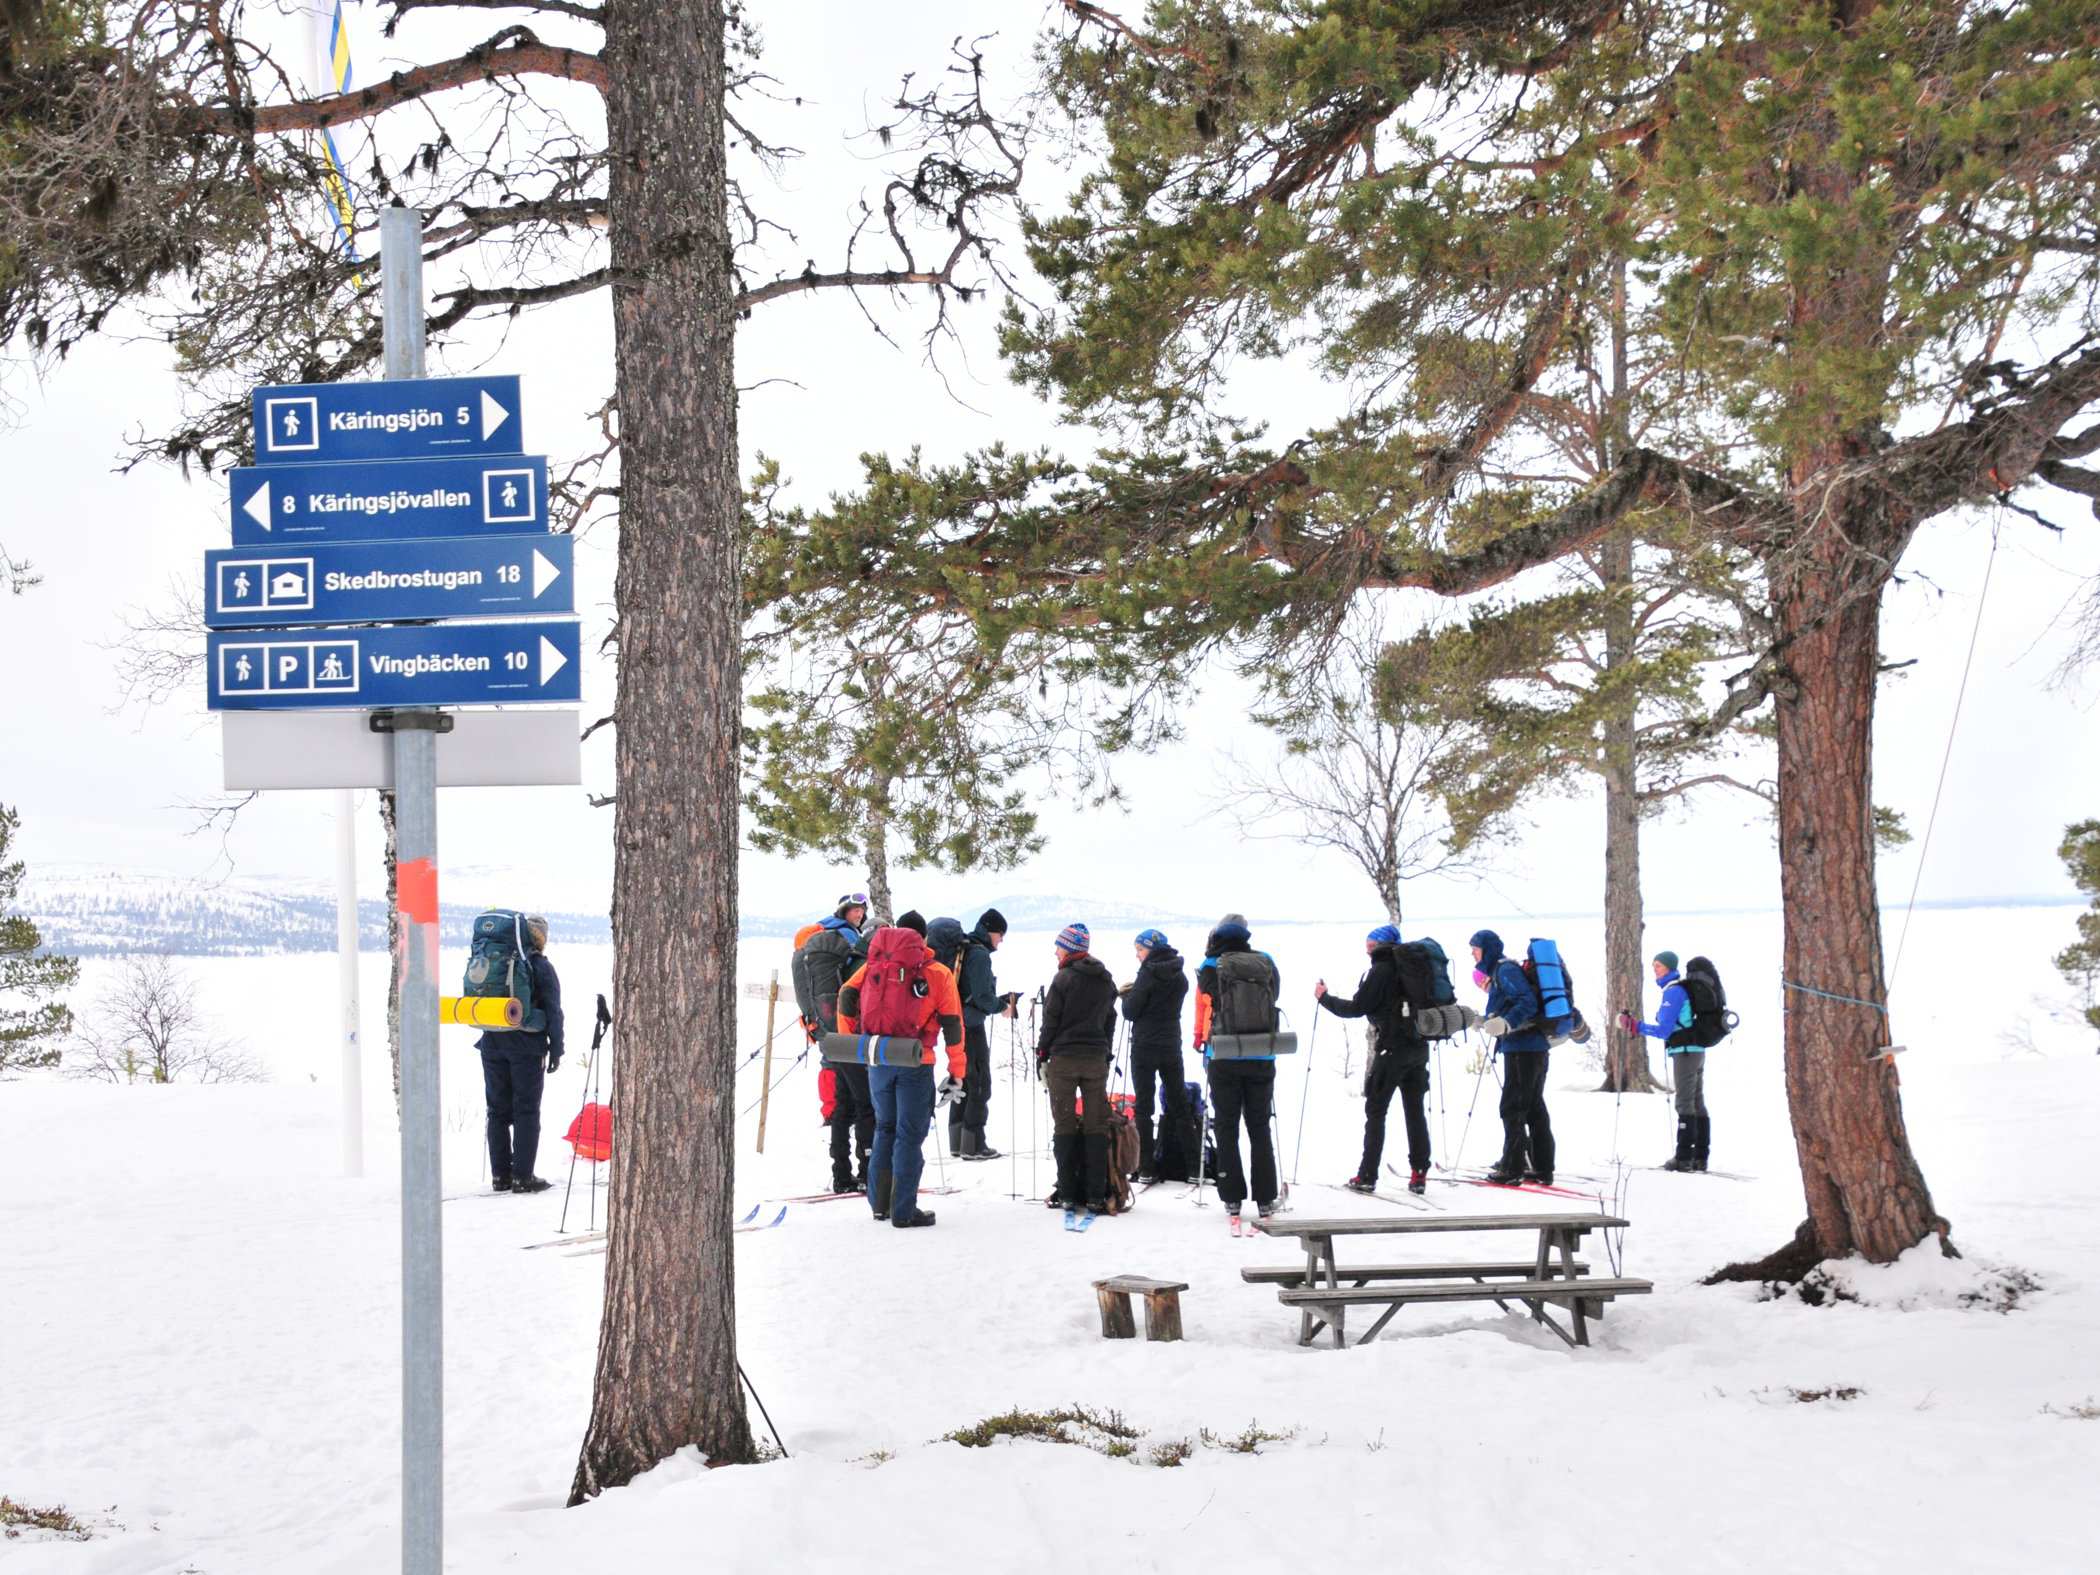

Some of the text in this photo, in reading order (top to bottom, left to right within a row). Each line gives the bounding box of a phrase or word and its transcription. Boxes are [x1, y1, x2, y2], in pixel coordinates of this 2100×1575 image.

[329, 407, 470, 432] Käringsjön 5
[283, 489, 471, 515] 8 Käringsjövallen
[325, 565, 521, 592] Skedbrostugan 18
[279, 656, 299, 682] P
[370, 652, 528, 678] Vingbäcken 10
